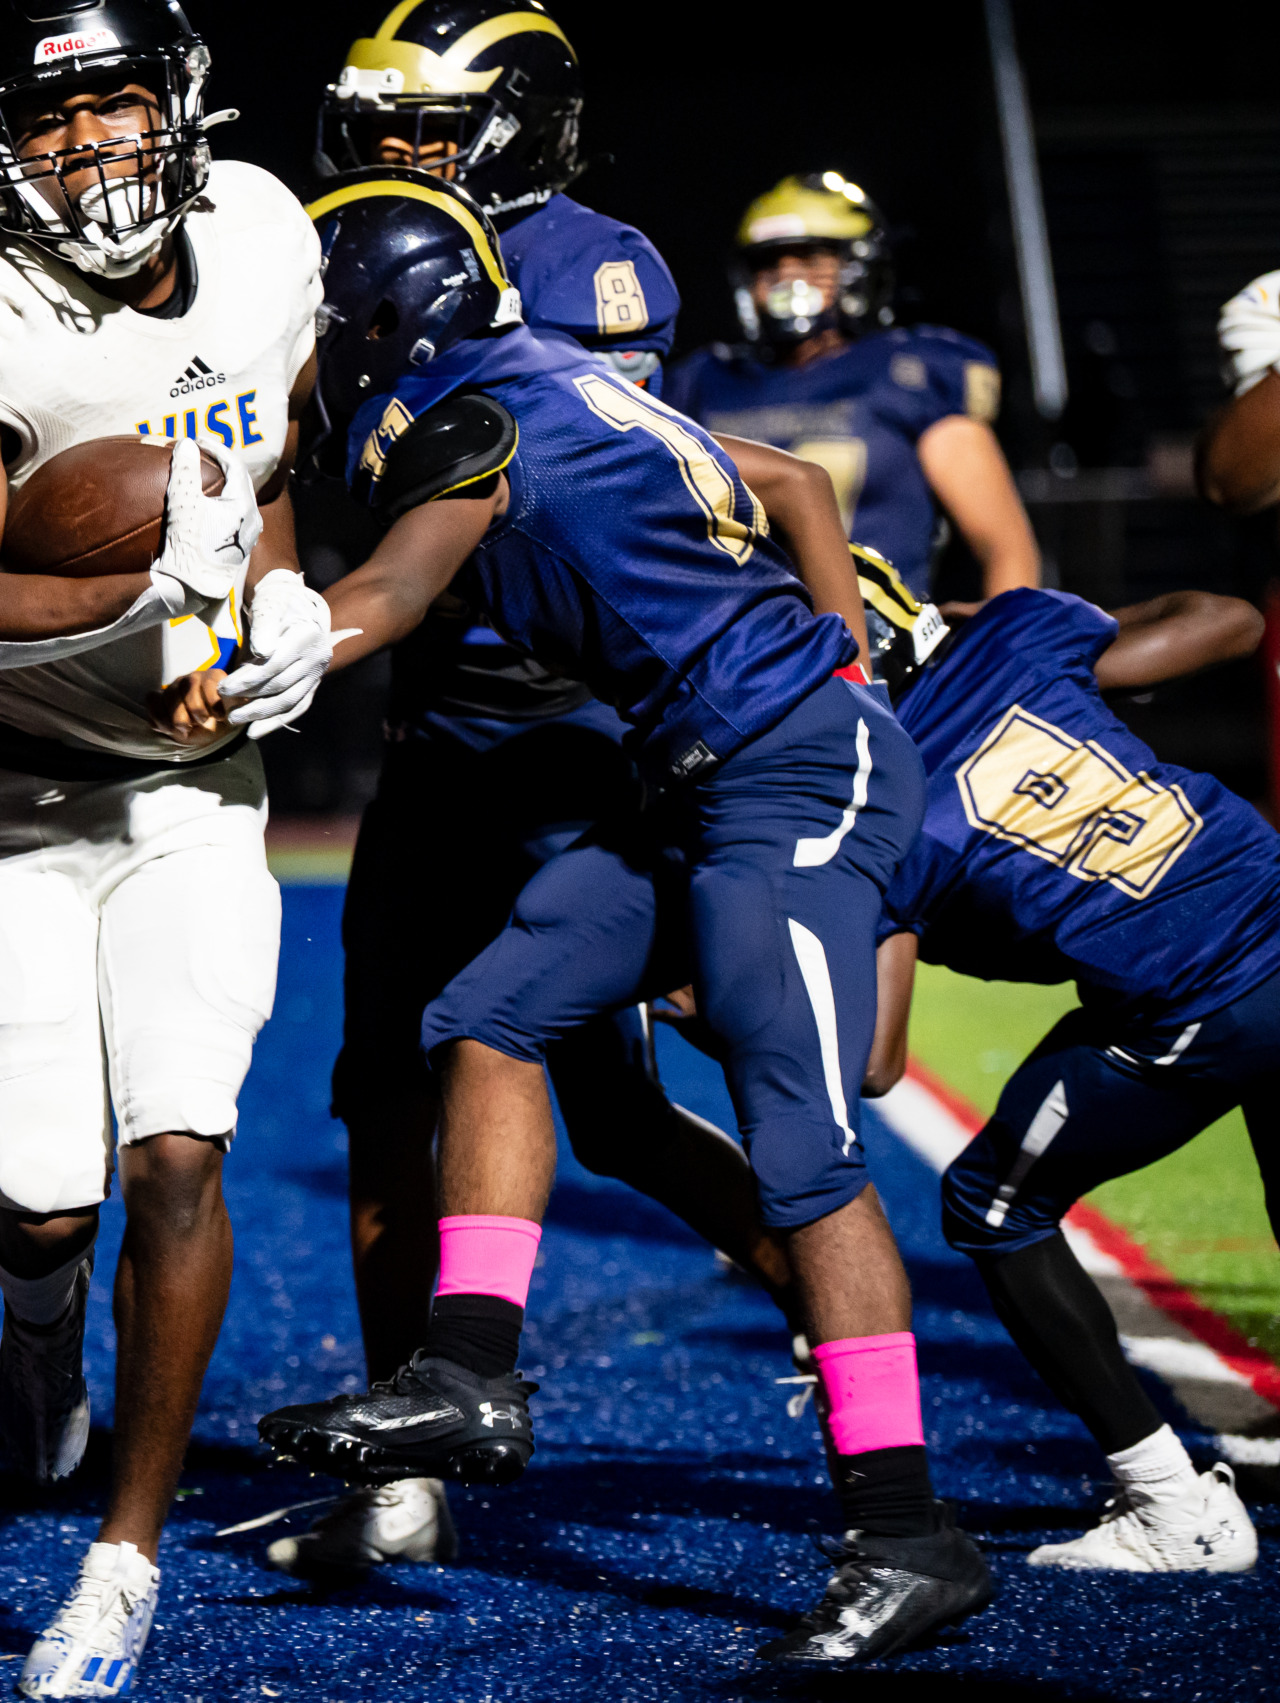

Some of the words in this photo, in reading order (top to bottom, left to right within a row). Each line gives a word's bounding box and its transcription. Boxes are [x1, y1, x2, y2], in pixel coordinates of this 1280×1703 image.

[593, 259, 650, 335] 8
[170, 372, 227, 399] adidas
[572, 371, 772, 569] 1
[955, 703, 1204, 901] 9
